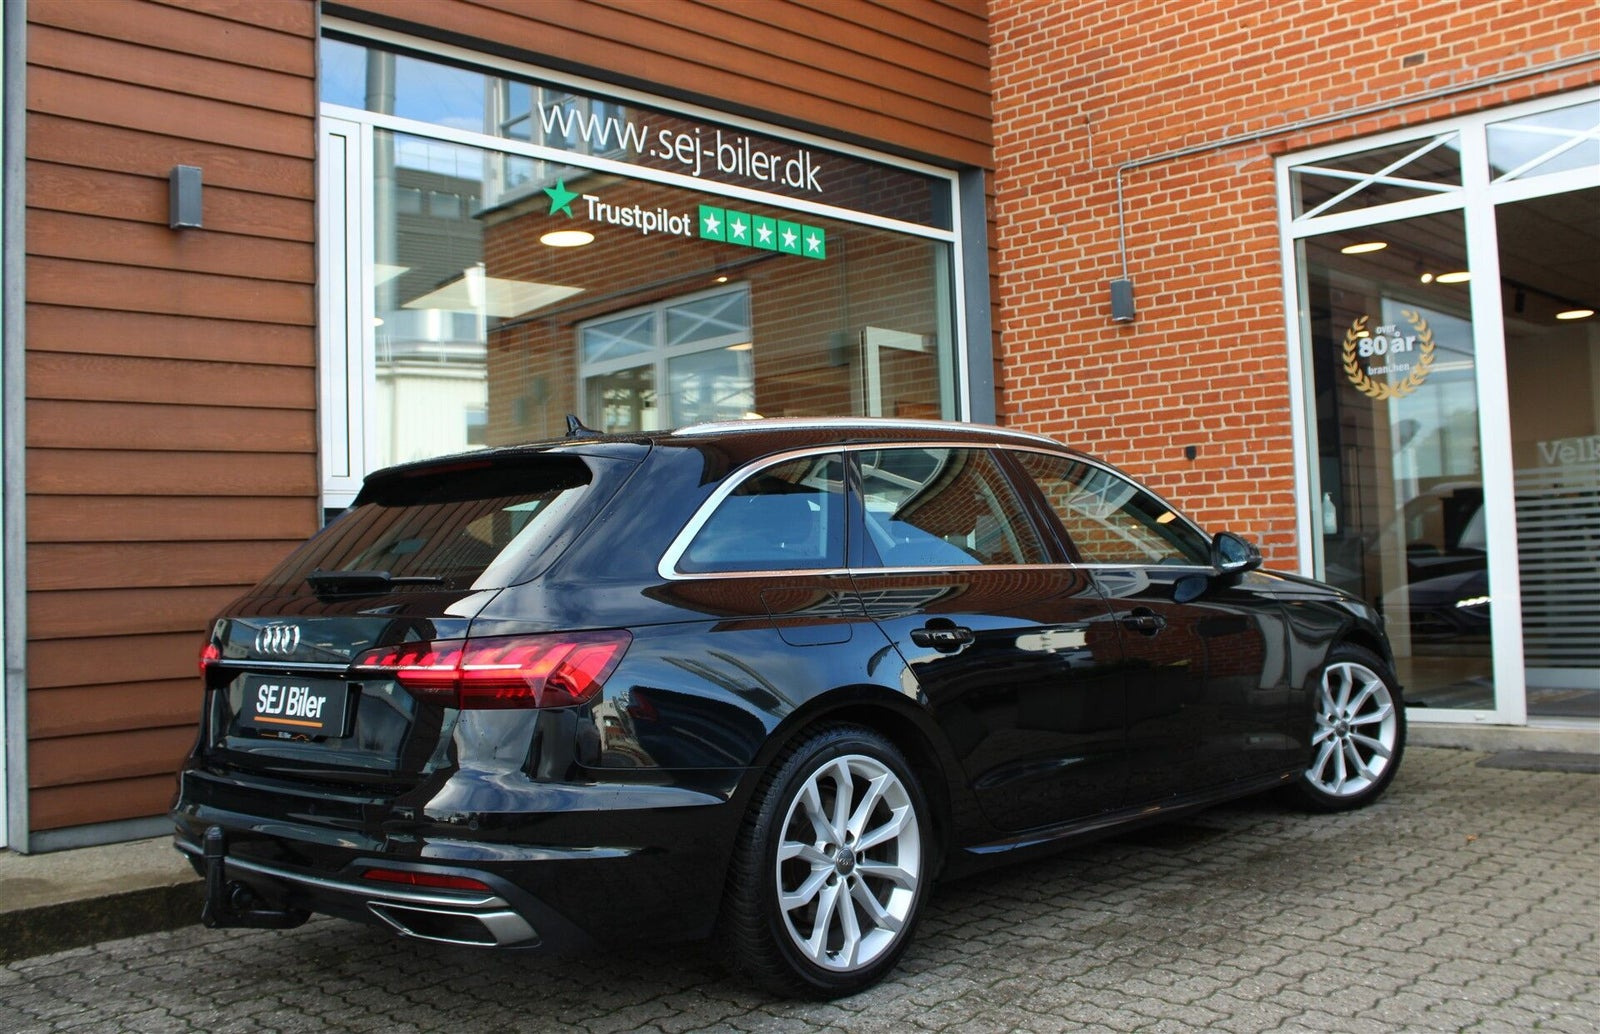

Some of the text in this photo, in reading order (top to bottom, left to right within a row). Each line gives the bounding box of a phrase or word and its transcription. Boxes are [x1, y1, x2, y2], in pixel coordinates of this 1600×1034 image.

[538, 102, 823, 192] www.sej-biler.dk
[583, 194, 691, 236] Trustpilot
[1359, 331, 1416, 357] 80 år
[1376, 324, 1396, 334] over
[256, 684, 326, 718] SEJ Biler
